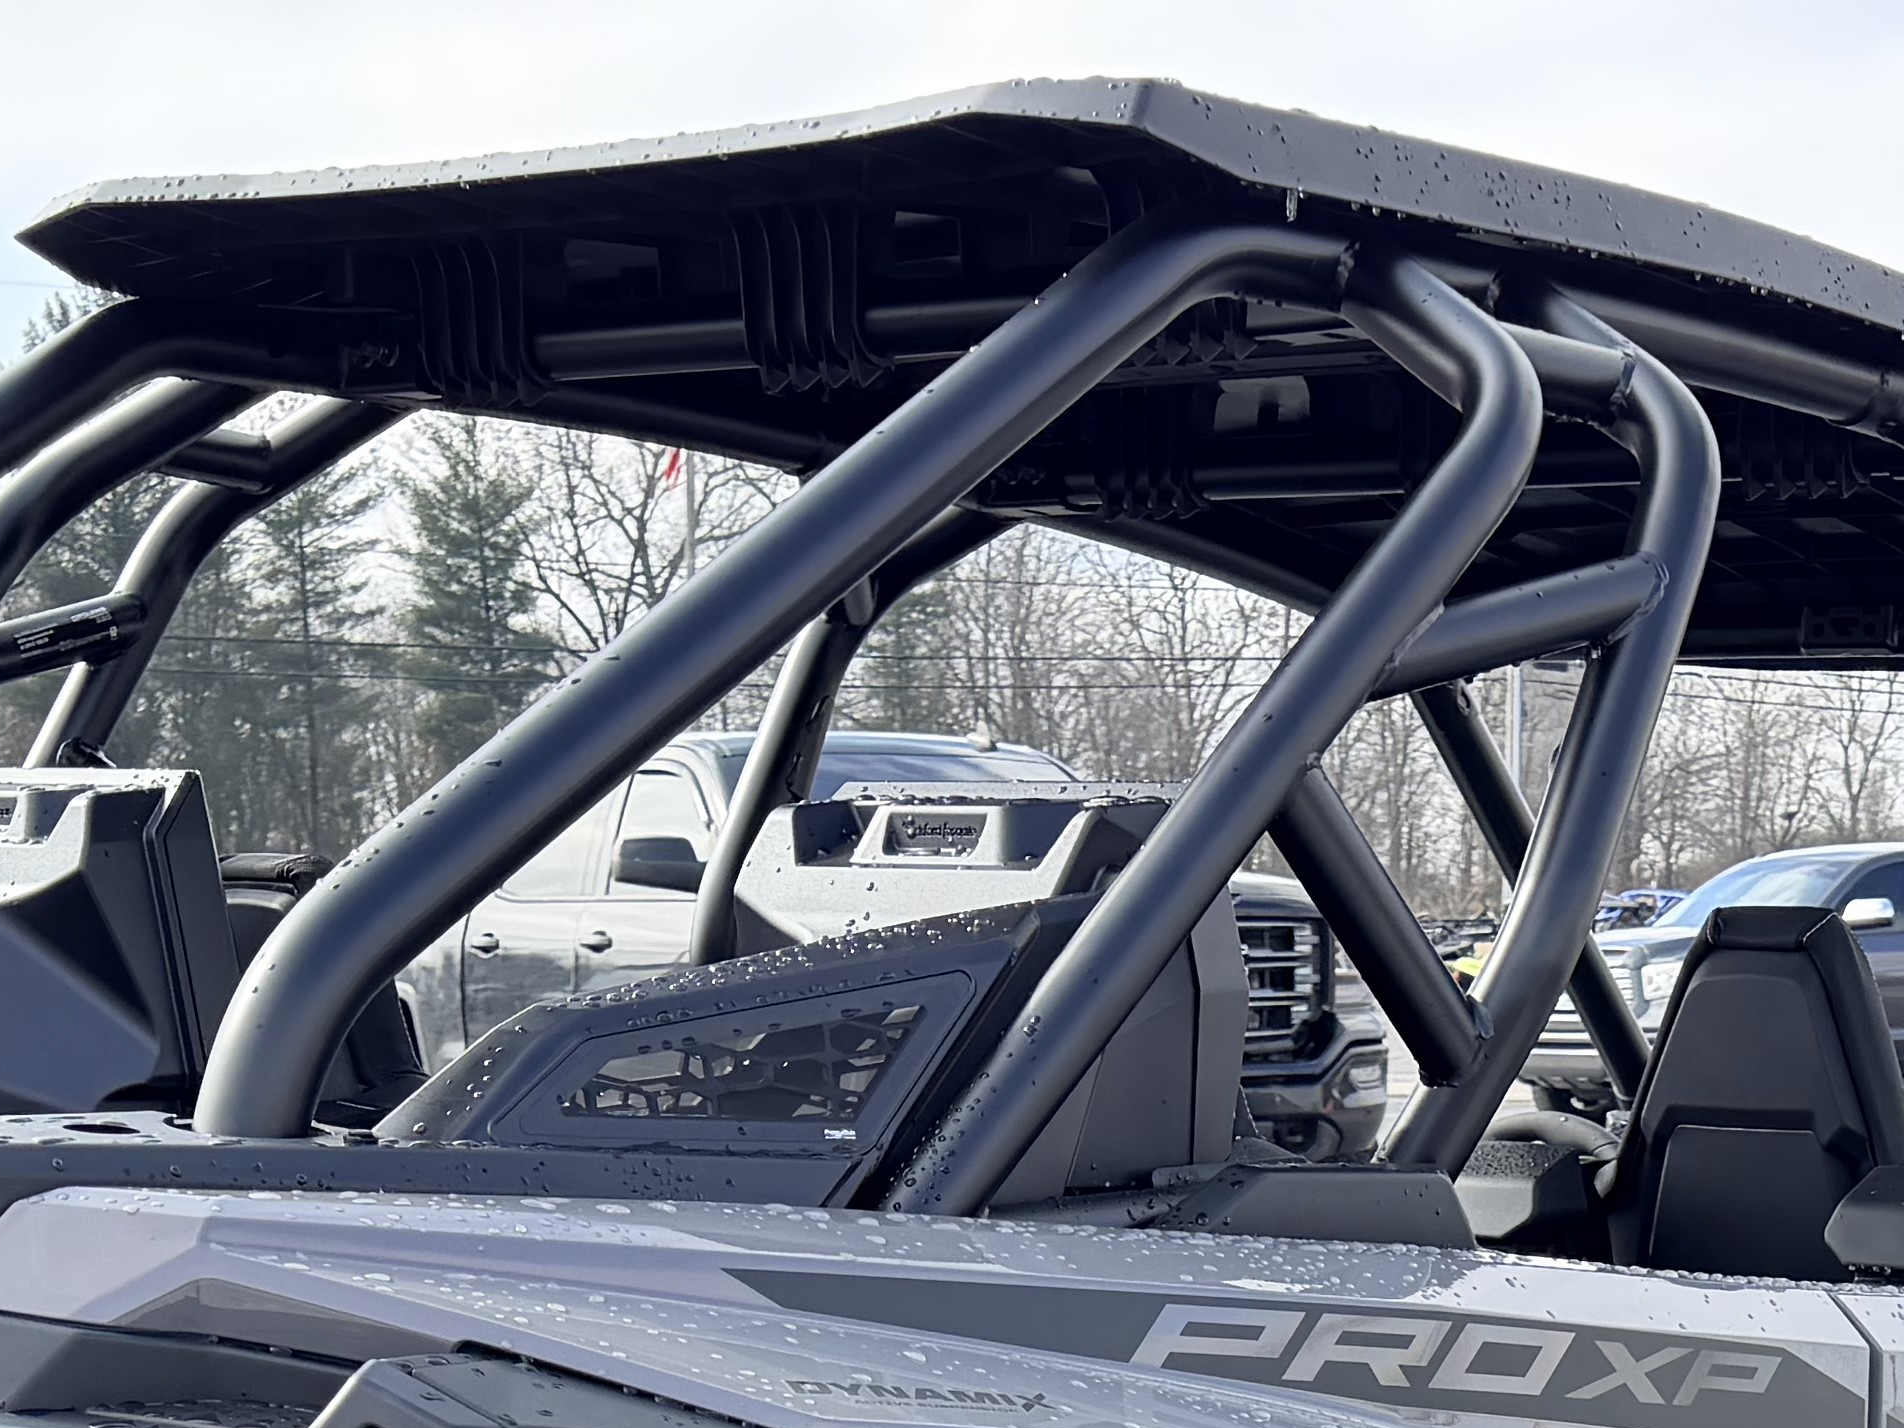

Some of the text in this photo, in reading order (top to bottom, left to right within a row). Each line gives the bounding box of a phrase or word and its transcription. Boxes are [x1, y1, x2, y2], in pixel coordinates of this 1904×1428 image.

[1130, 1302, 1781, 1406] PRO XP
[784, 1380, 1057, 1412] DYNAMIX
